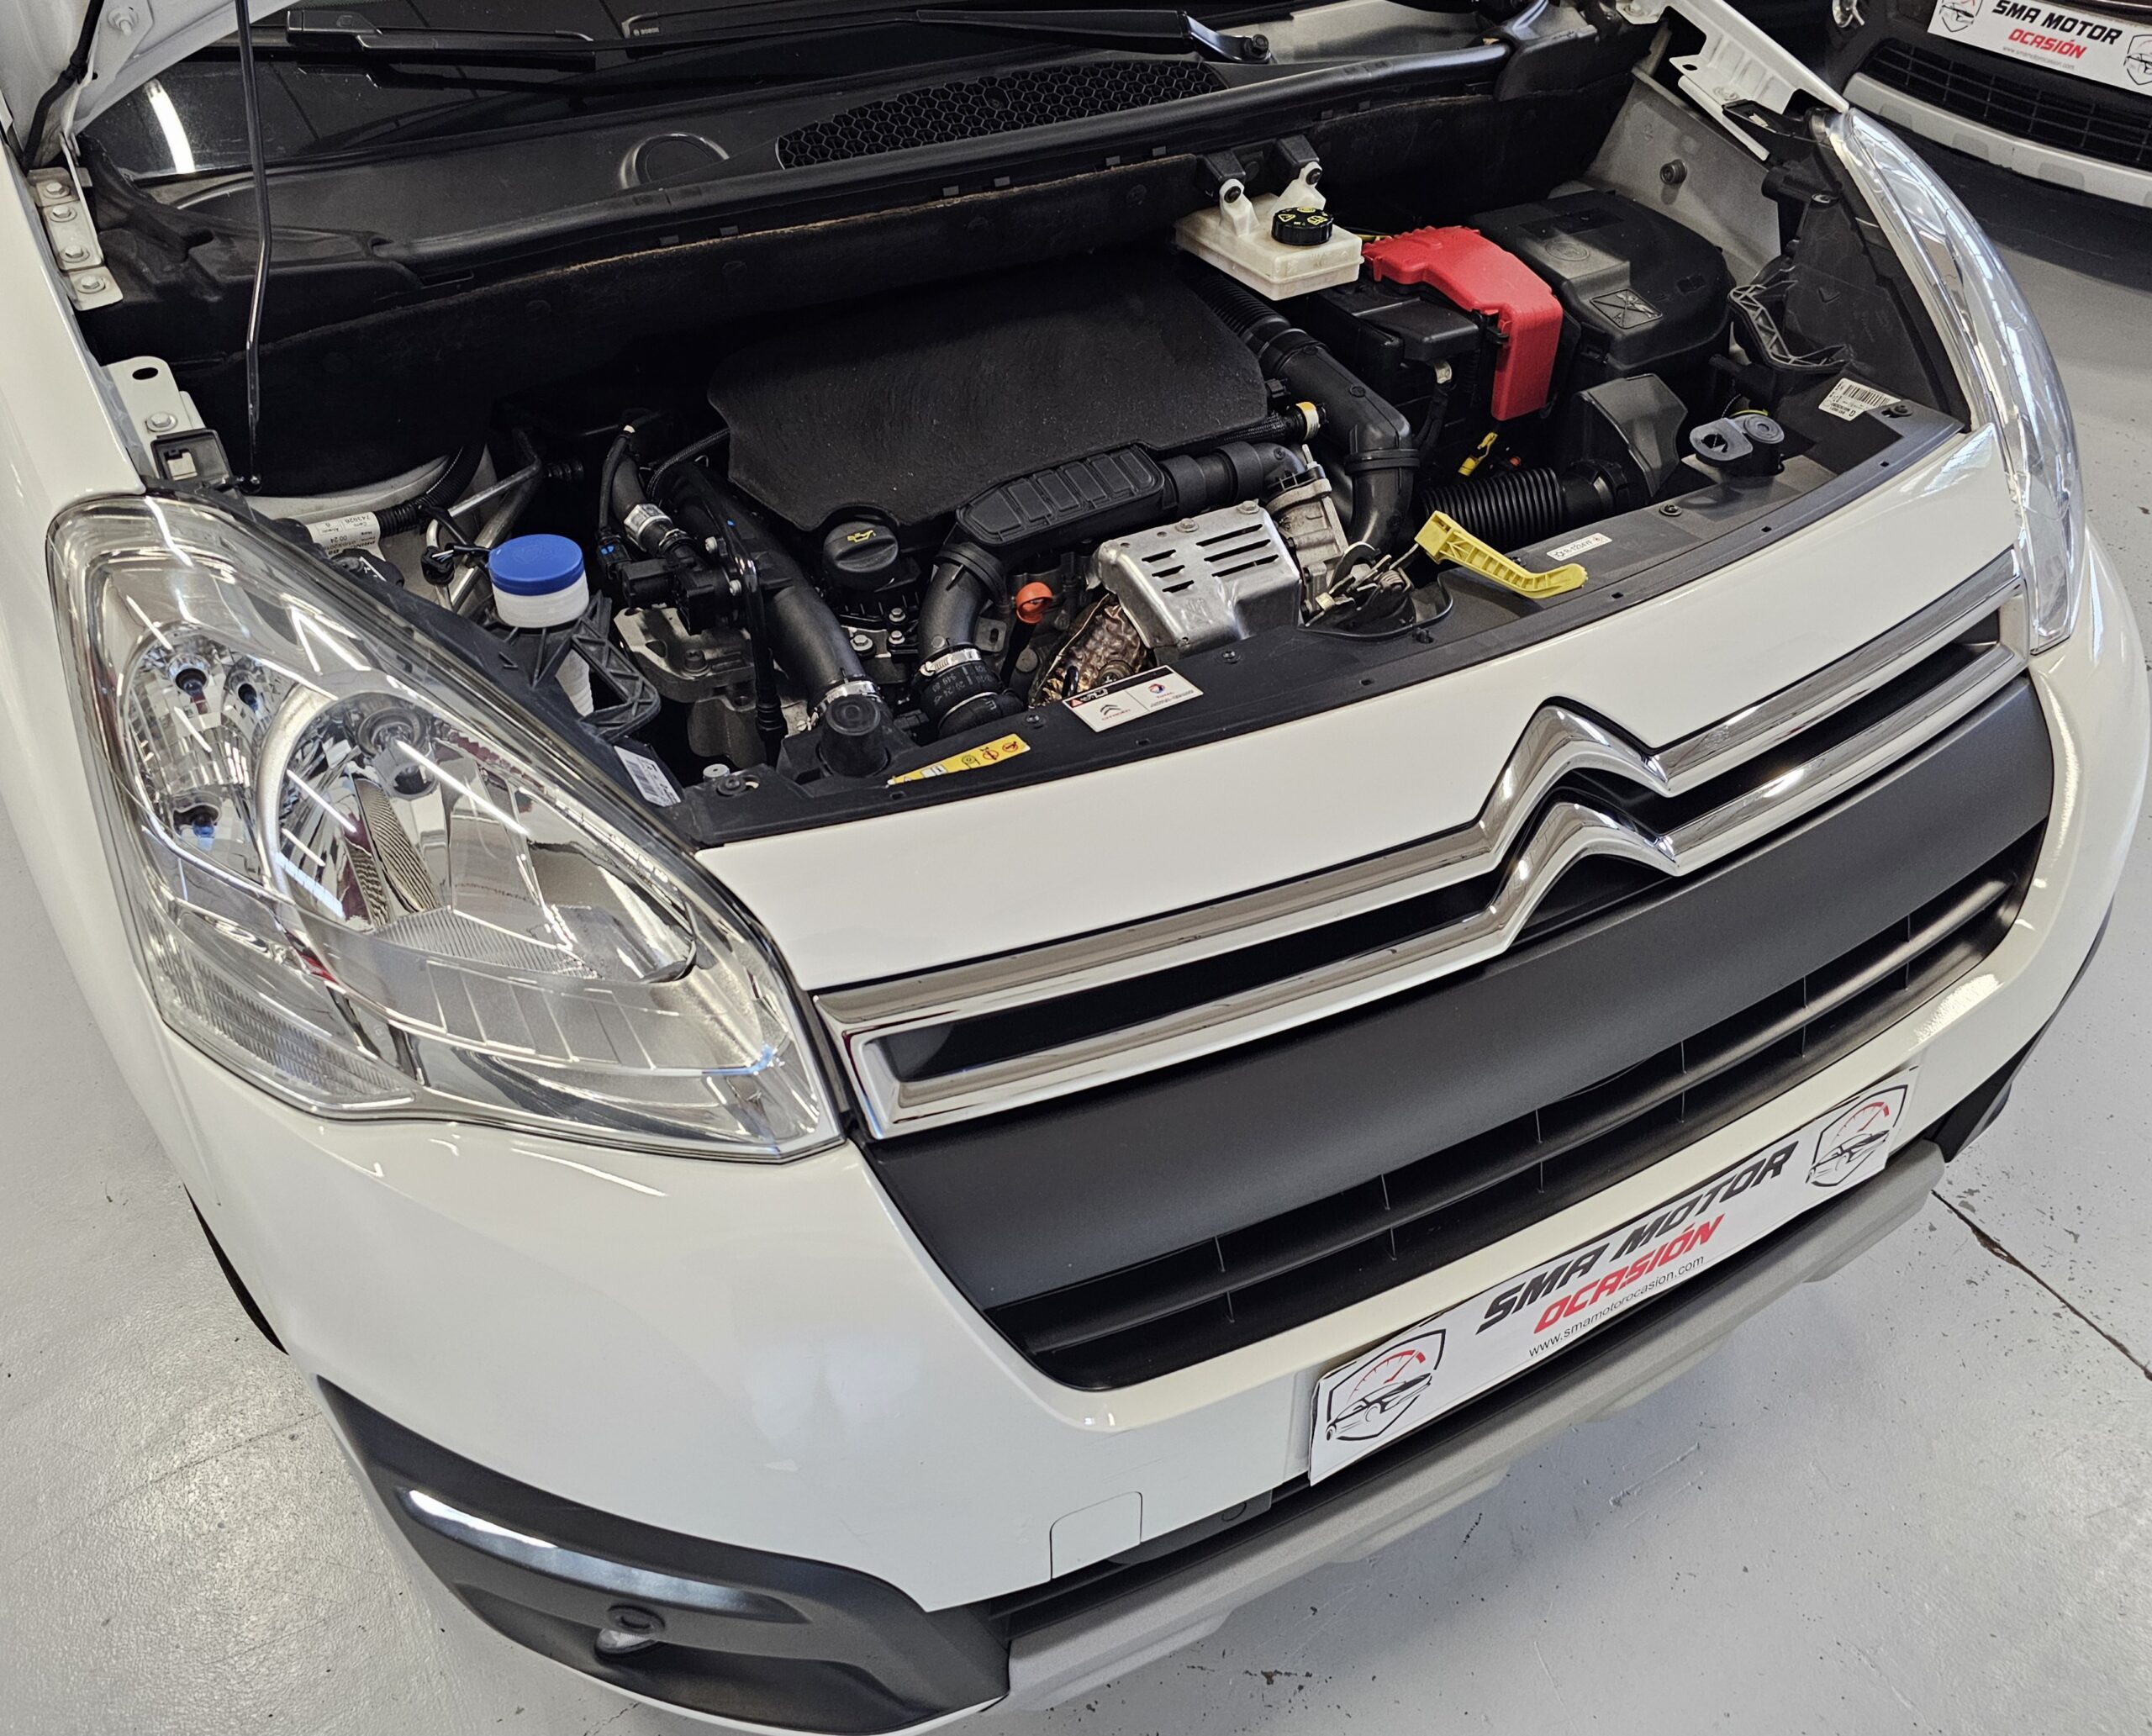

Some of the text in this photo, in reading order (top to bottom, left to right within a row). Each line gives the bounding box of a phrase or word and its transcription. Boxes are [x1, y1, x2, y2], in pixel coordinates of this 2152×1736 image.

[1992, 0, 2123, 45] SMA MOTOR
[2008, 29, 2087, 59] OCASIÓN
[1475, 1141, 1799, 1336] SMA MOTOR
[1533, 1213, 1726, 1334] OCASIÓN
[1527, 1255, 1706, 1359] www.smamotorocasion.com
